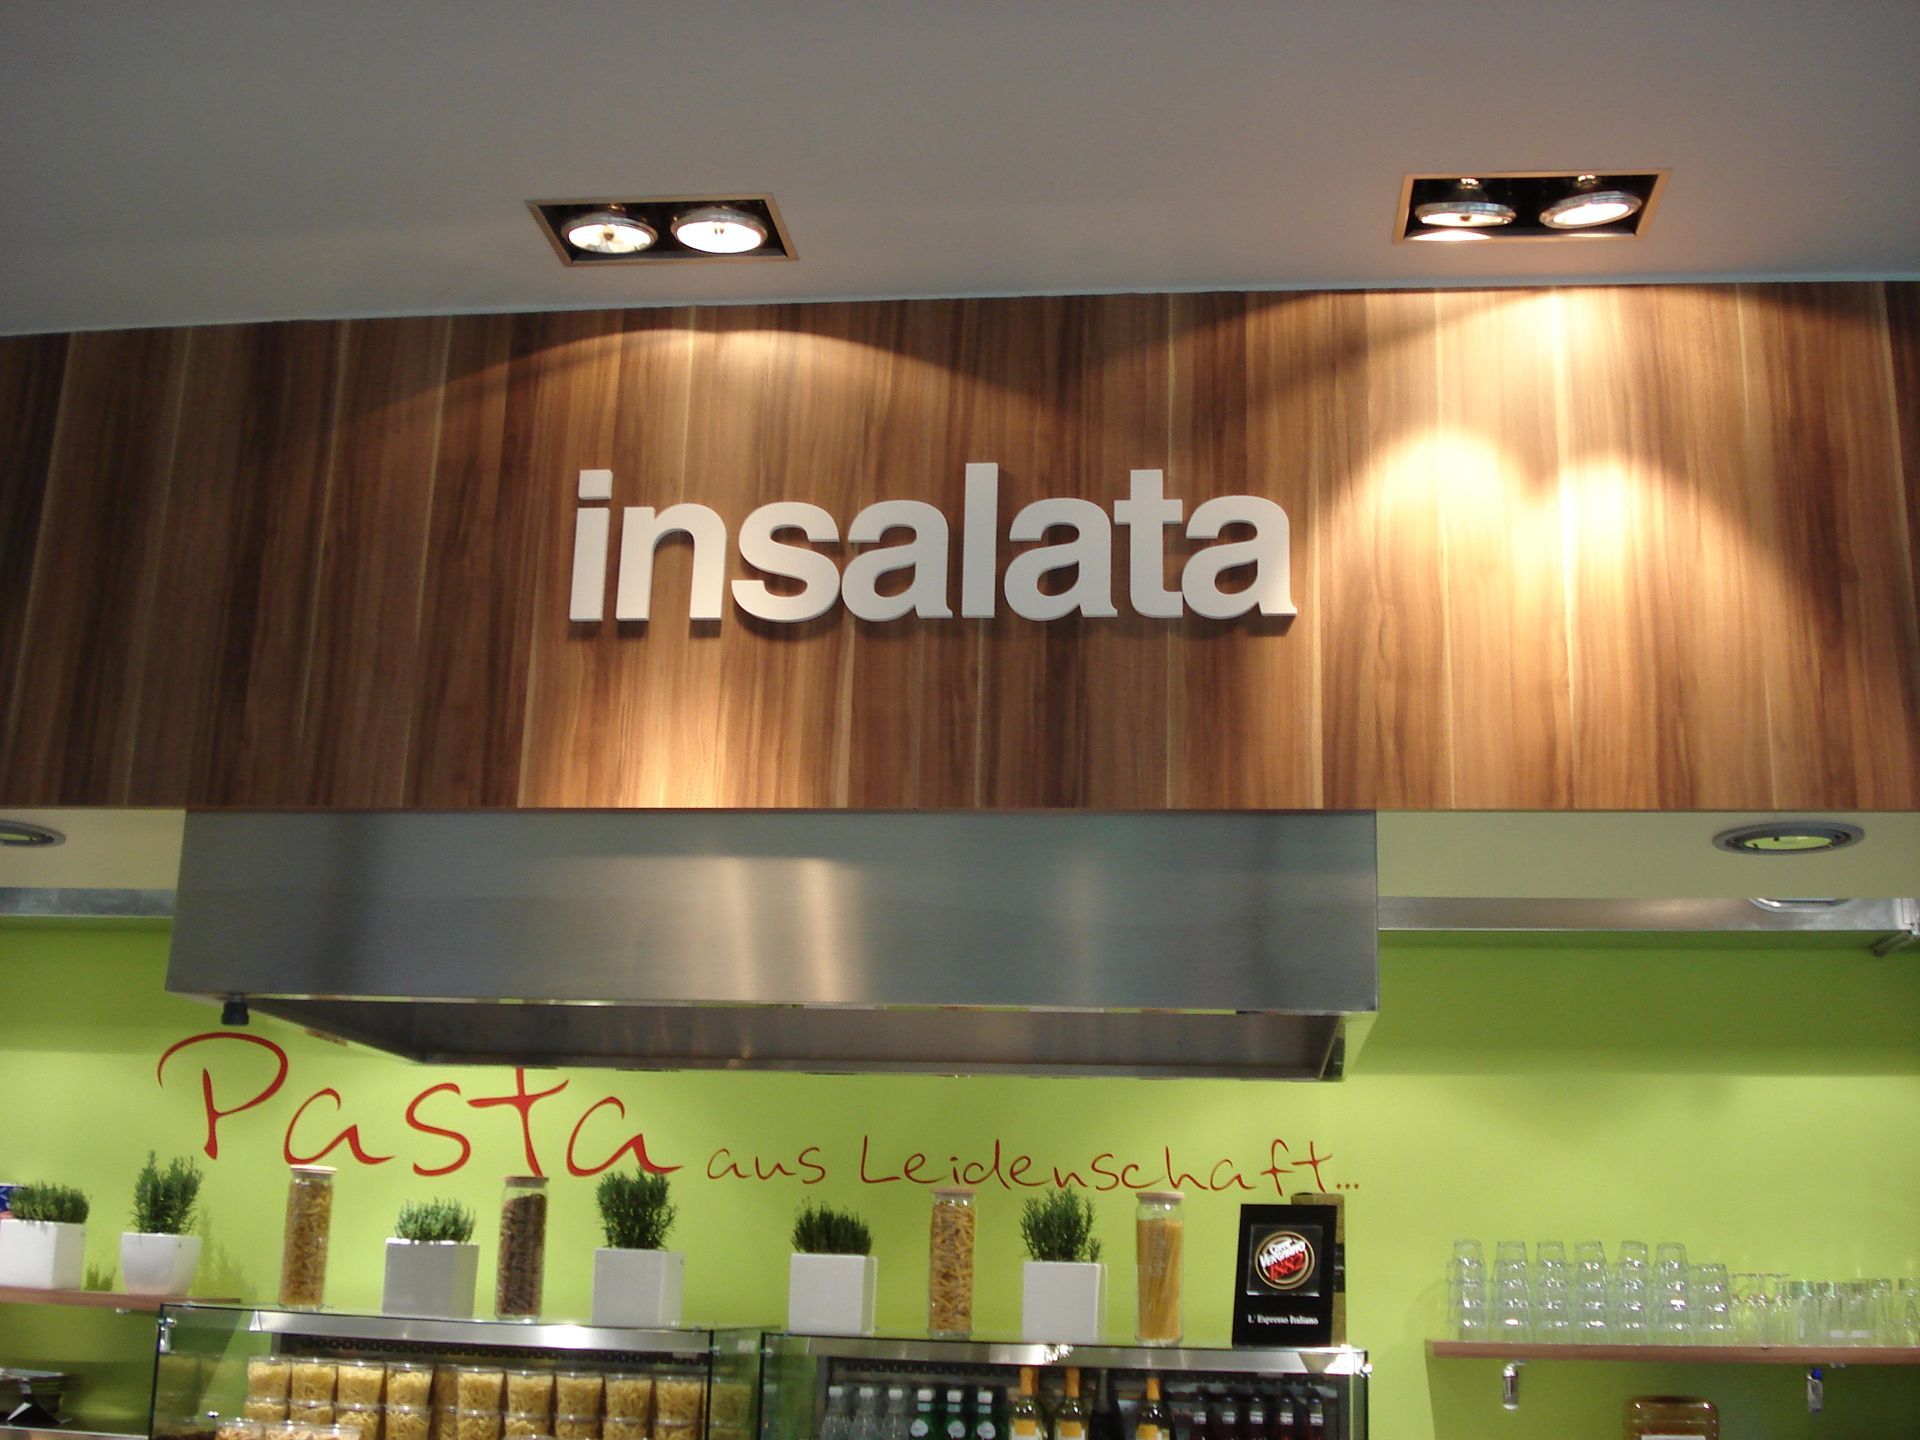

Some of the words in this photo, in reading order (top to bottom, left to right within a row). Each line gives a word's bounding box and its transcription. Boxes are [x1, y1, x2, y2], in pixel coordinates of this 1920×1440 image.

[570, 463, 1296, 621] insalata
[157, 1032, 682, 1180] Pasta
[708, 1145, 827, 1185] aus
